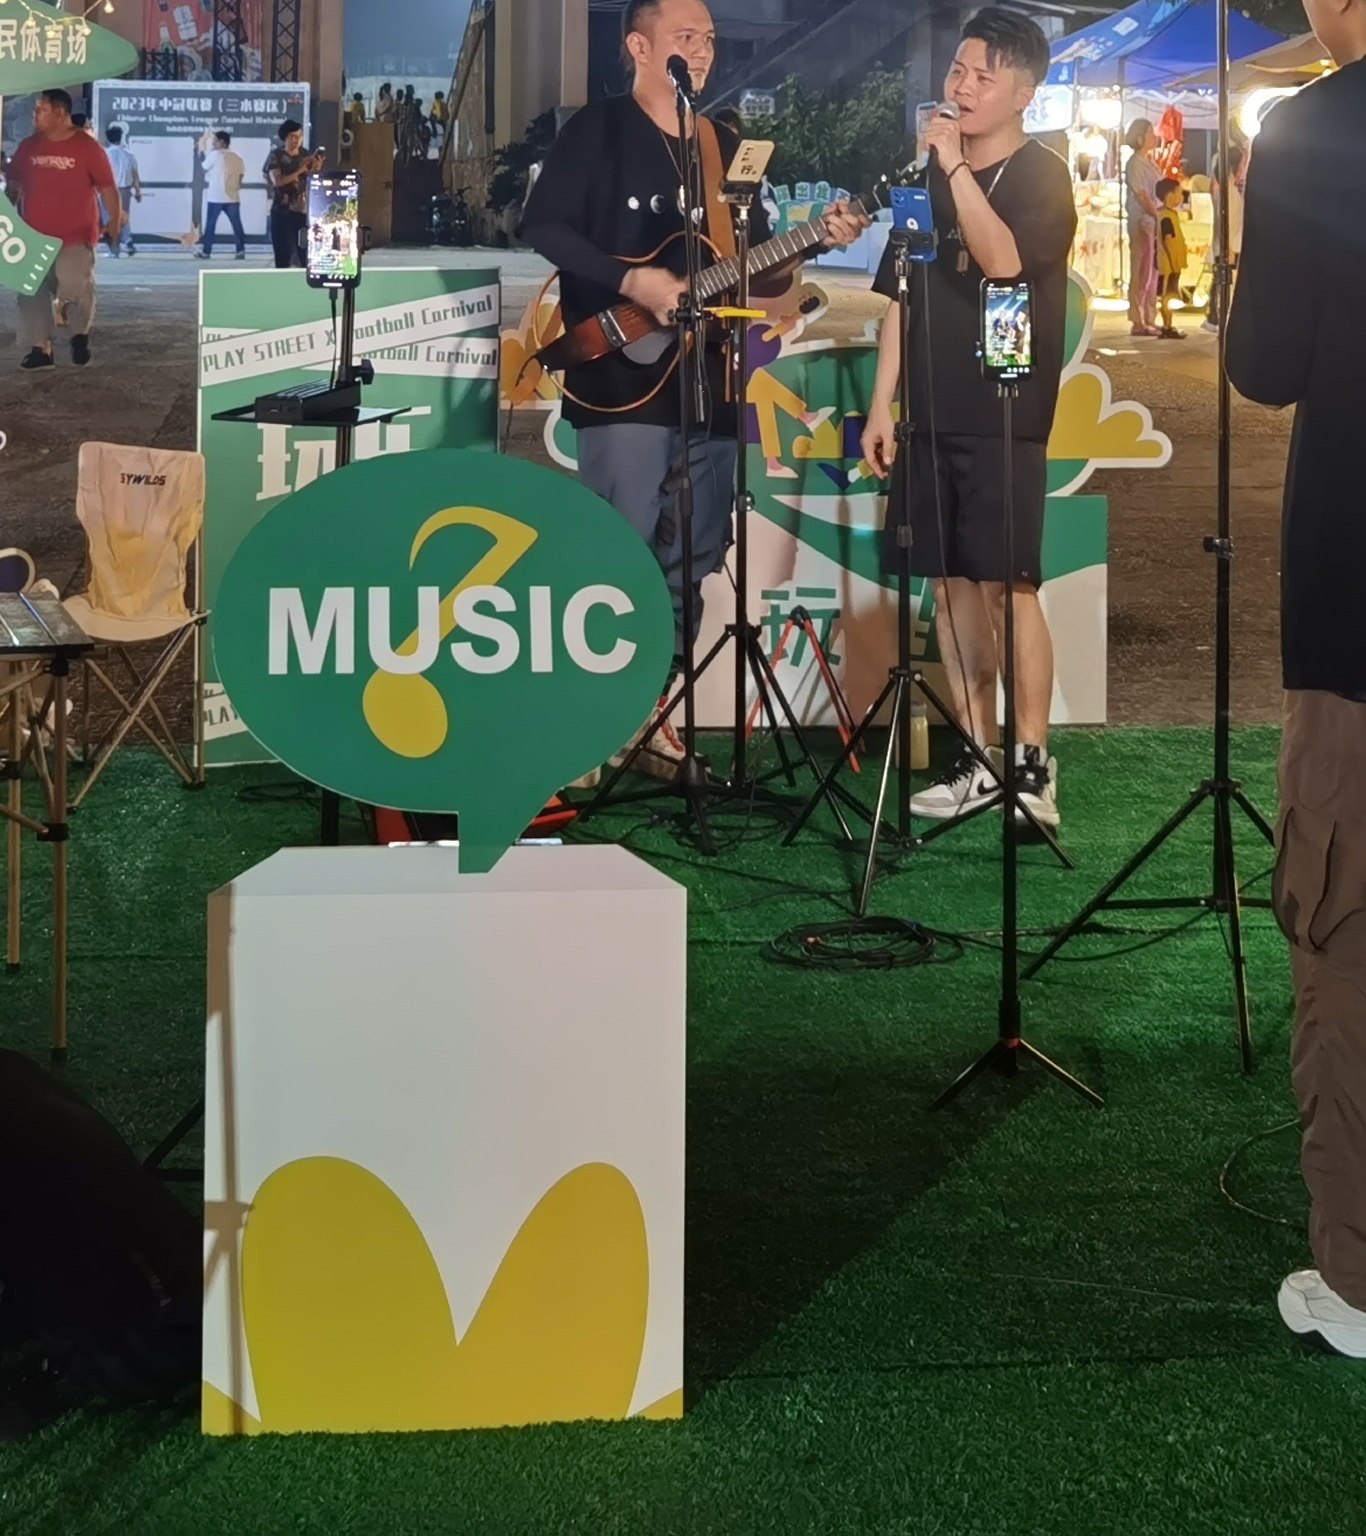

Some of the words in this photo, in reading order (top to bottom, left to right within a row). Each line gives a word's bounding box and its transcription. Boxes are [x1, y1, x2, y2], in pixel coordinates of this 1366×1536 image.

[202, 345, 246, 373] PLAY
[253, 331, 317, 363] STREET
[354, 311, 416, 341] ootball
[421, 294, 493, 325] Carnival
[425, 345, 497, 367] Carnival
[120, 472, 167, 486] SYWILDS
[267, 583, 638, 676] MUSIC
